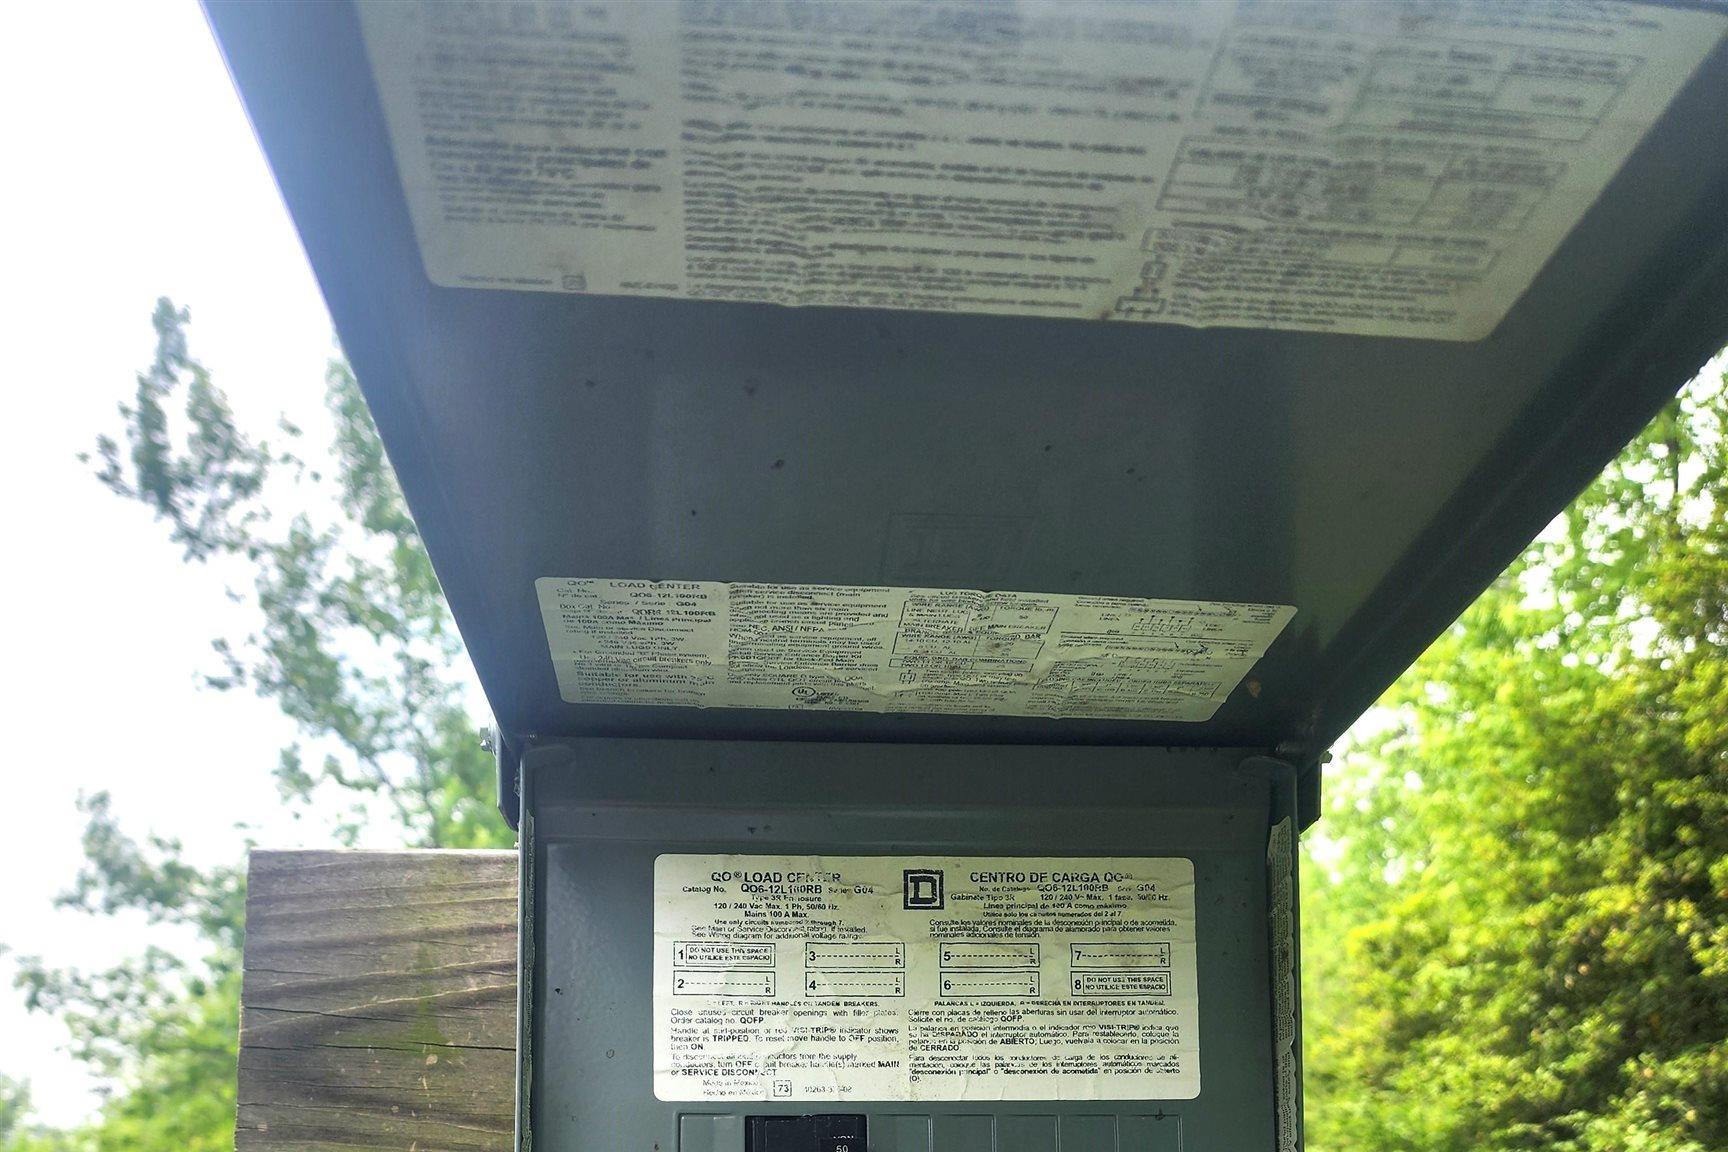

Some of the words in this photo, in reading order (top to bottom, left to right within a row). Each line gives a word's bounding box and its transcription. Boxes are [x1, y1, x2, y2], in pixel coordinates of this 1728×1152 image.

[744, 872, 782, 883] LOAD
[970, 872, 1026, 883] CENTRO
[1052, 872, 1099, 884] CARGA
[854, 885, 874, 894] G04
[770, 910, 782, 918] 100
[784, 910, 790, 918] A
[792, 910, 809, 918] Max.
[678, 949, 684, 960] 1
[809, 951, 816, 962] 3
[943, 950, 951, 962] 5
[1074, 950, 1082, 961] 7
[677, 978, 685, 989] 2
[808, 979, 816, 991] 4
[943, 979, 951, 991] 6
[1074, 979, 1082, 990] 8
